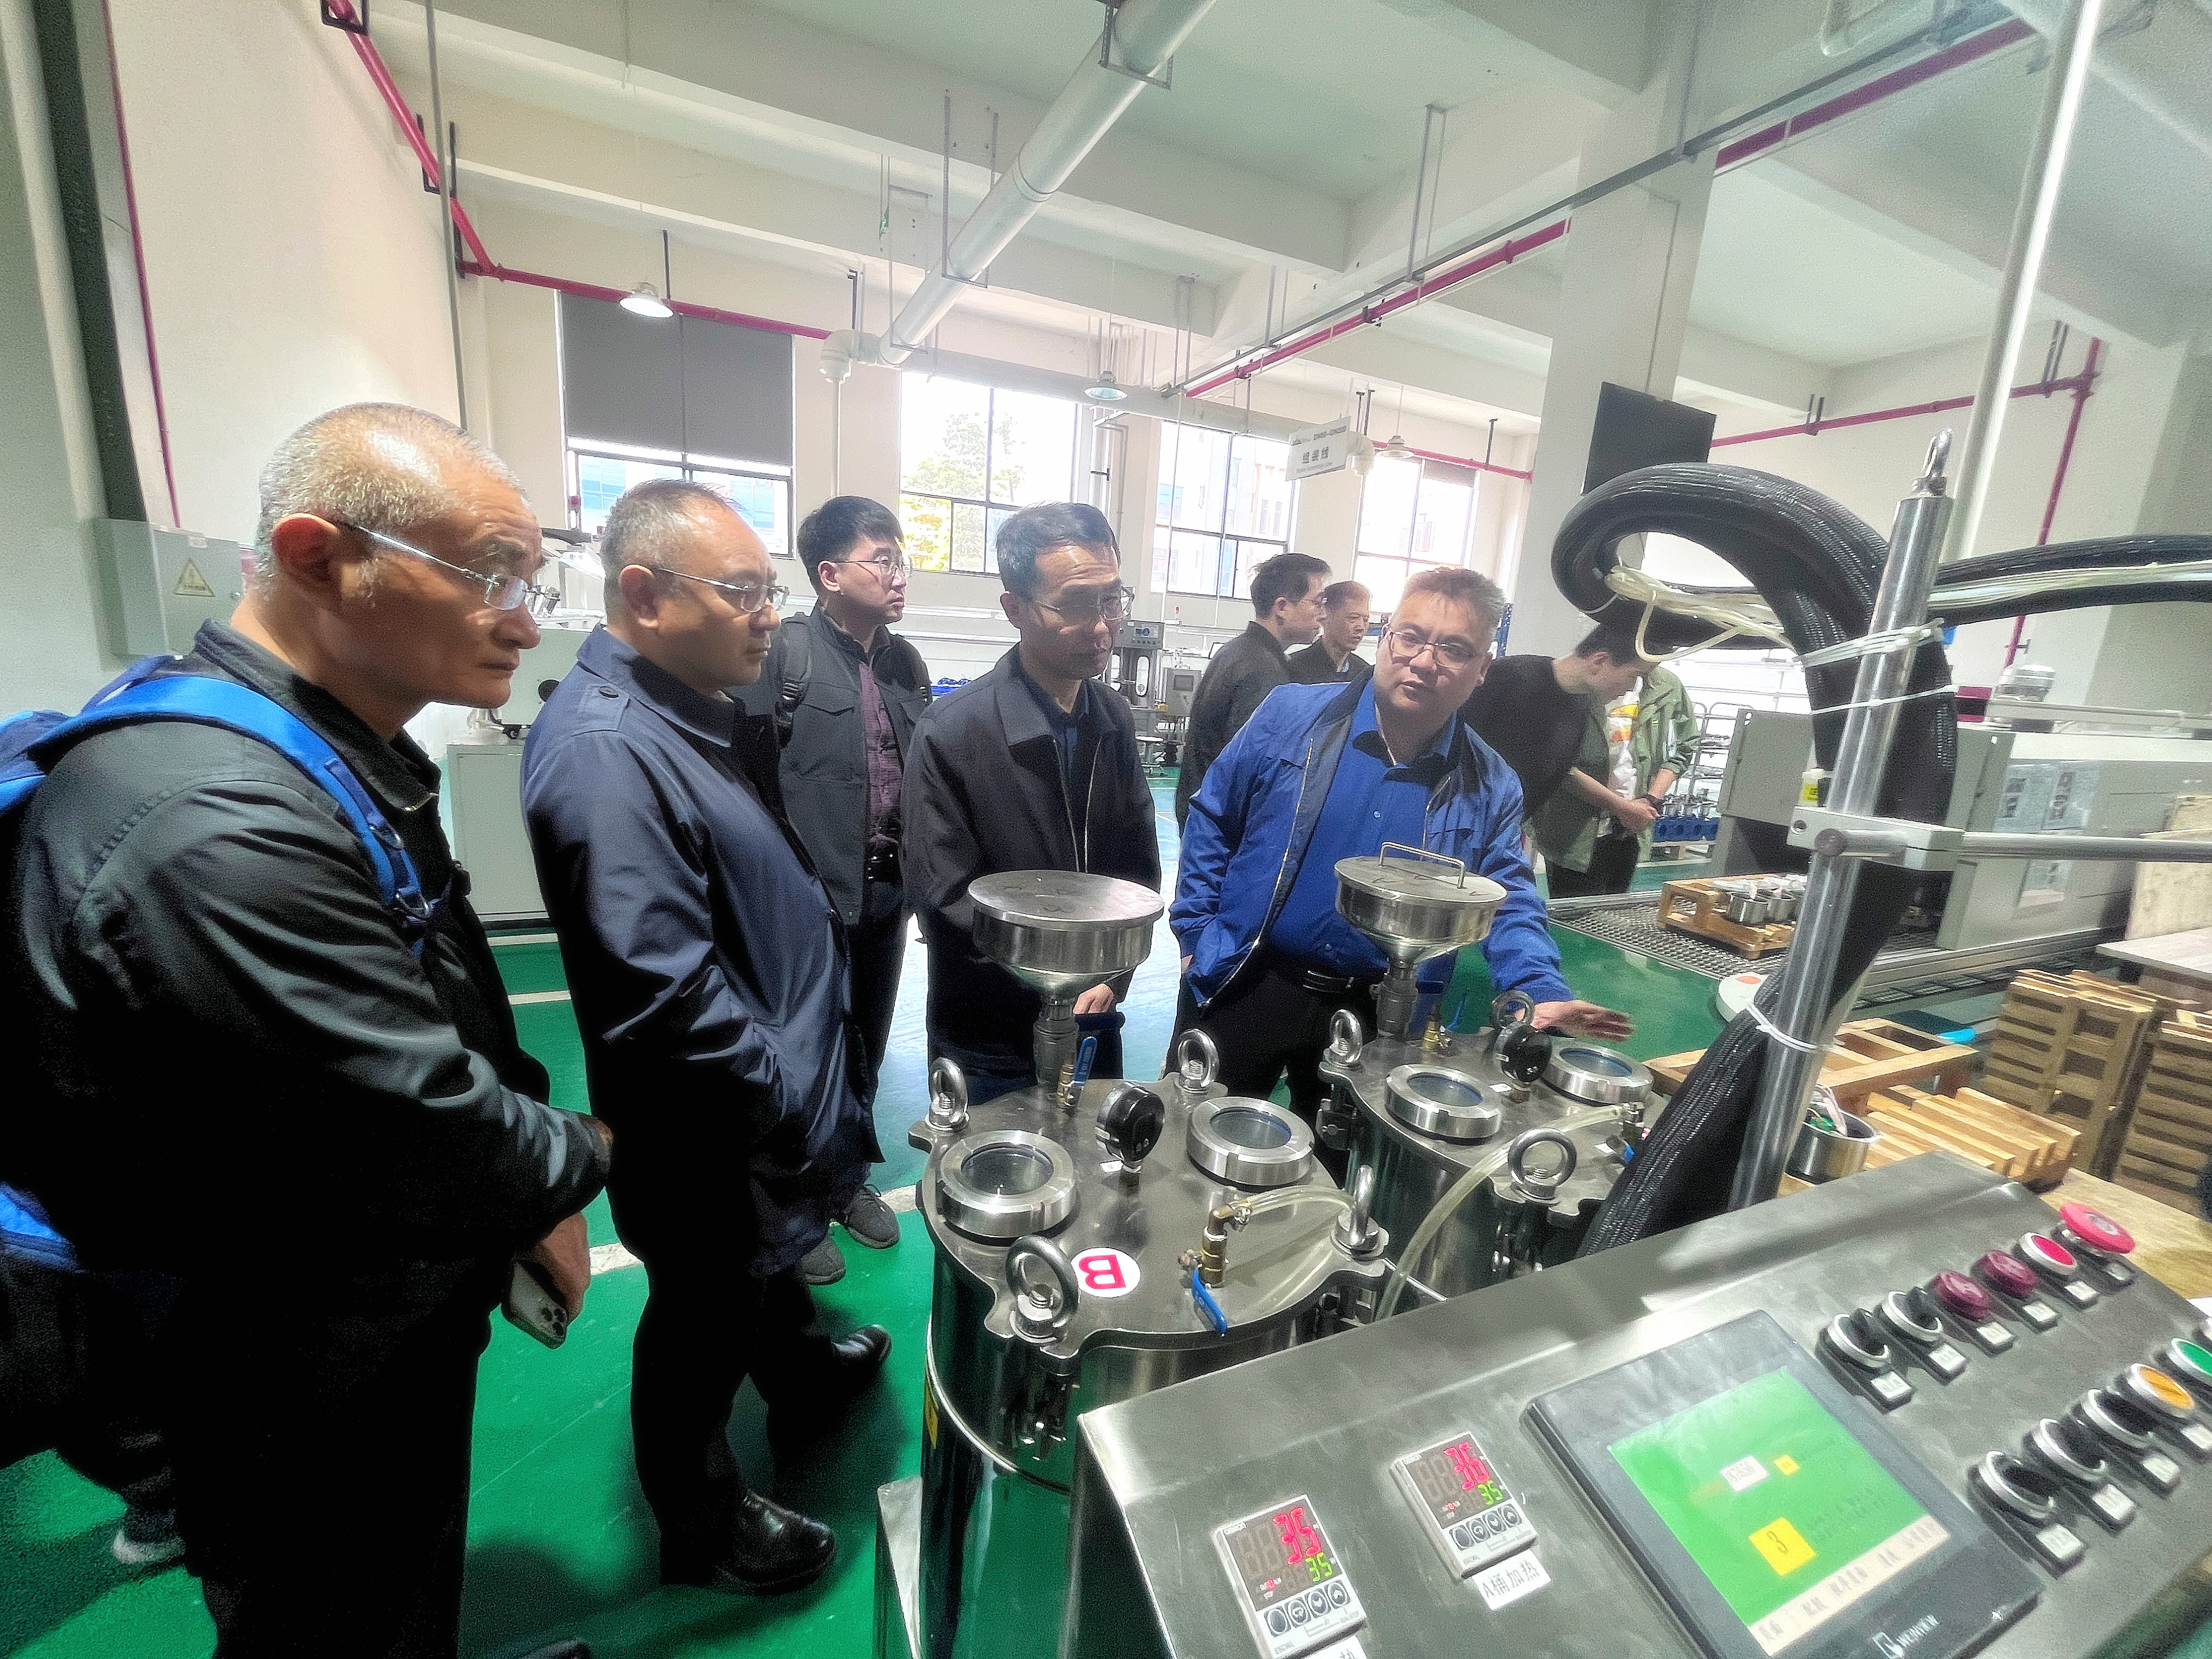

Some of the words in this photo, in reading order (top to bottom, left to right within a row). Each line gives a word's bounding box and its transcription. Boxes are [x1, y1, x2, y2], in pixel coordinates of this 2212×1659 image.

[1078, 1254, 1126, 1290] B
[1444, 1441, 1491, 1491] 36
[1477, 1480, 1504, 1506] 35
[1272, 1506, 1322, 1566] 35
[1767, 1530, 1790, 1555] 3
[1305, 1551, 1333, 1583] 35
[1482, 1558, 1540, 1599] A桶加热
